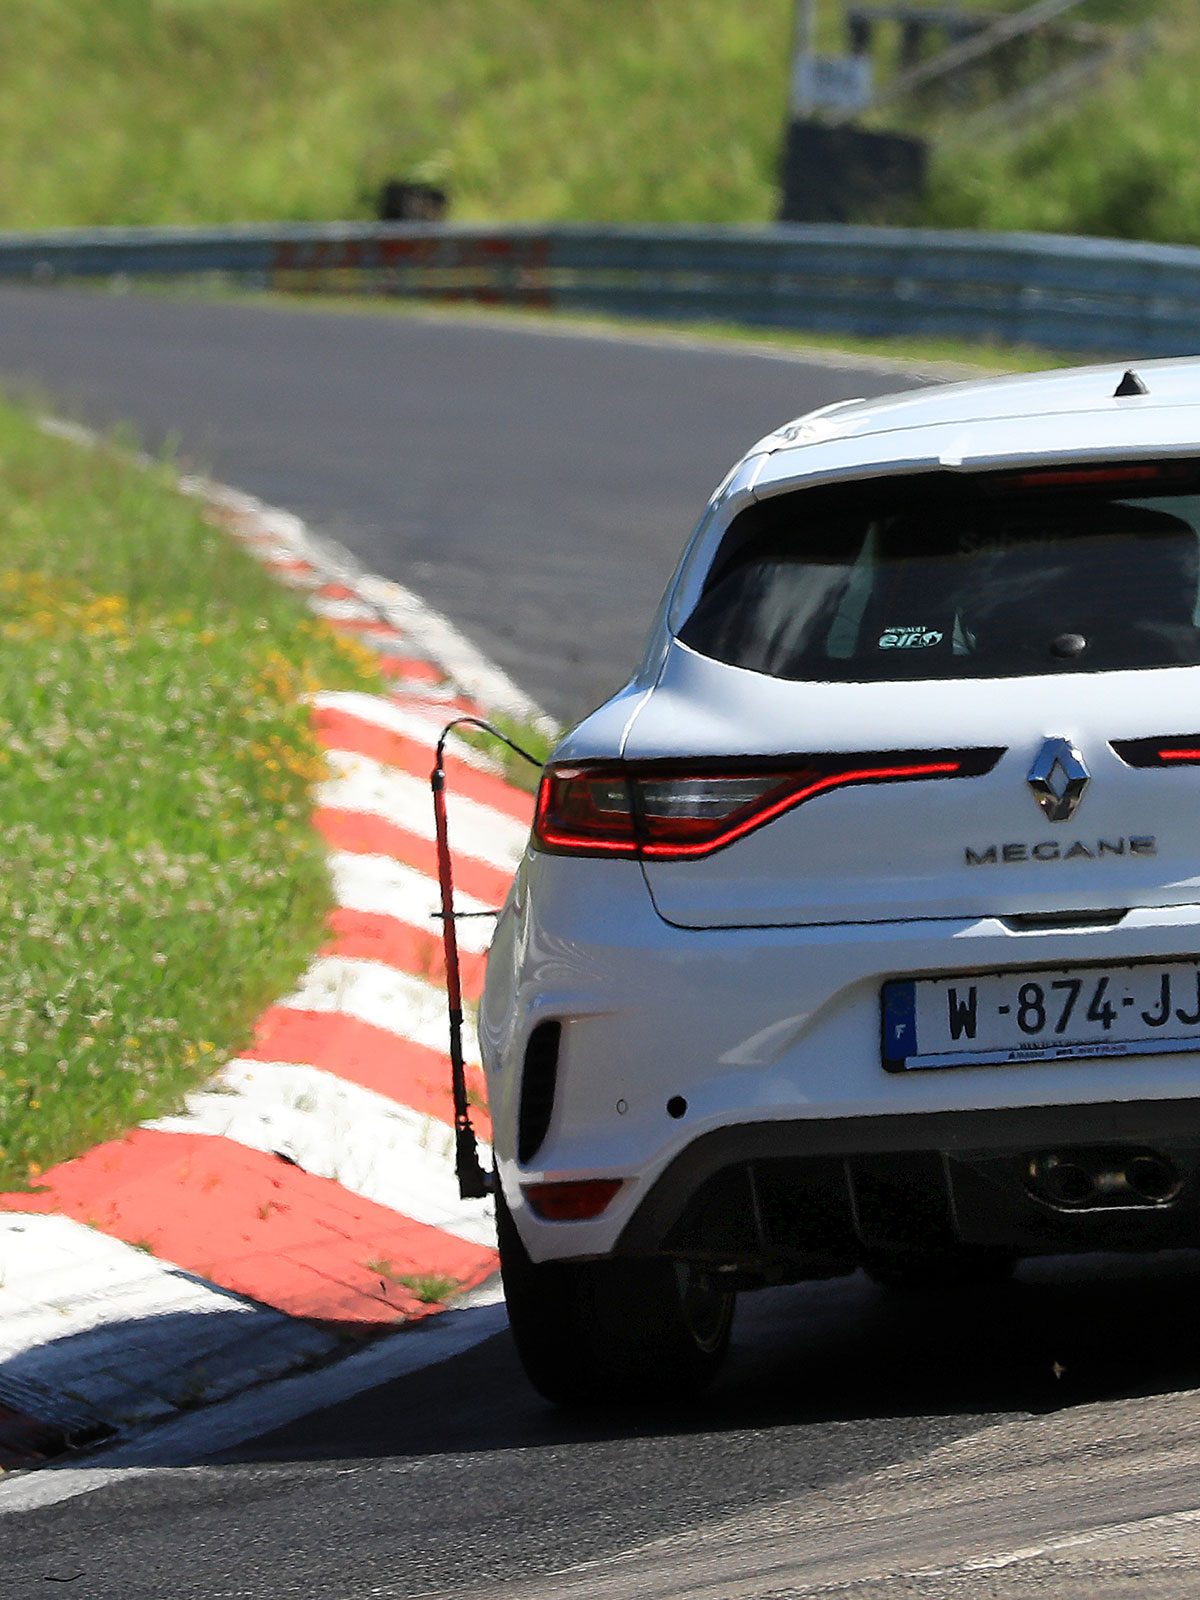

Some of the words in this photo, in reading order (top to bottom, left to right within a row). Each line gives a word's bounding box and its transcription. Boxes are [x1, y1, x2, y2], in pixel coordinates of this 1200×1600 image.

[879, 633, 922, 646] elf
[964, 835, 1157, 865] MEGANE
[895, 1023, 907, 1040] F
